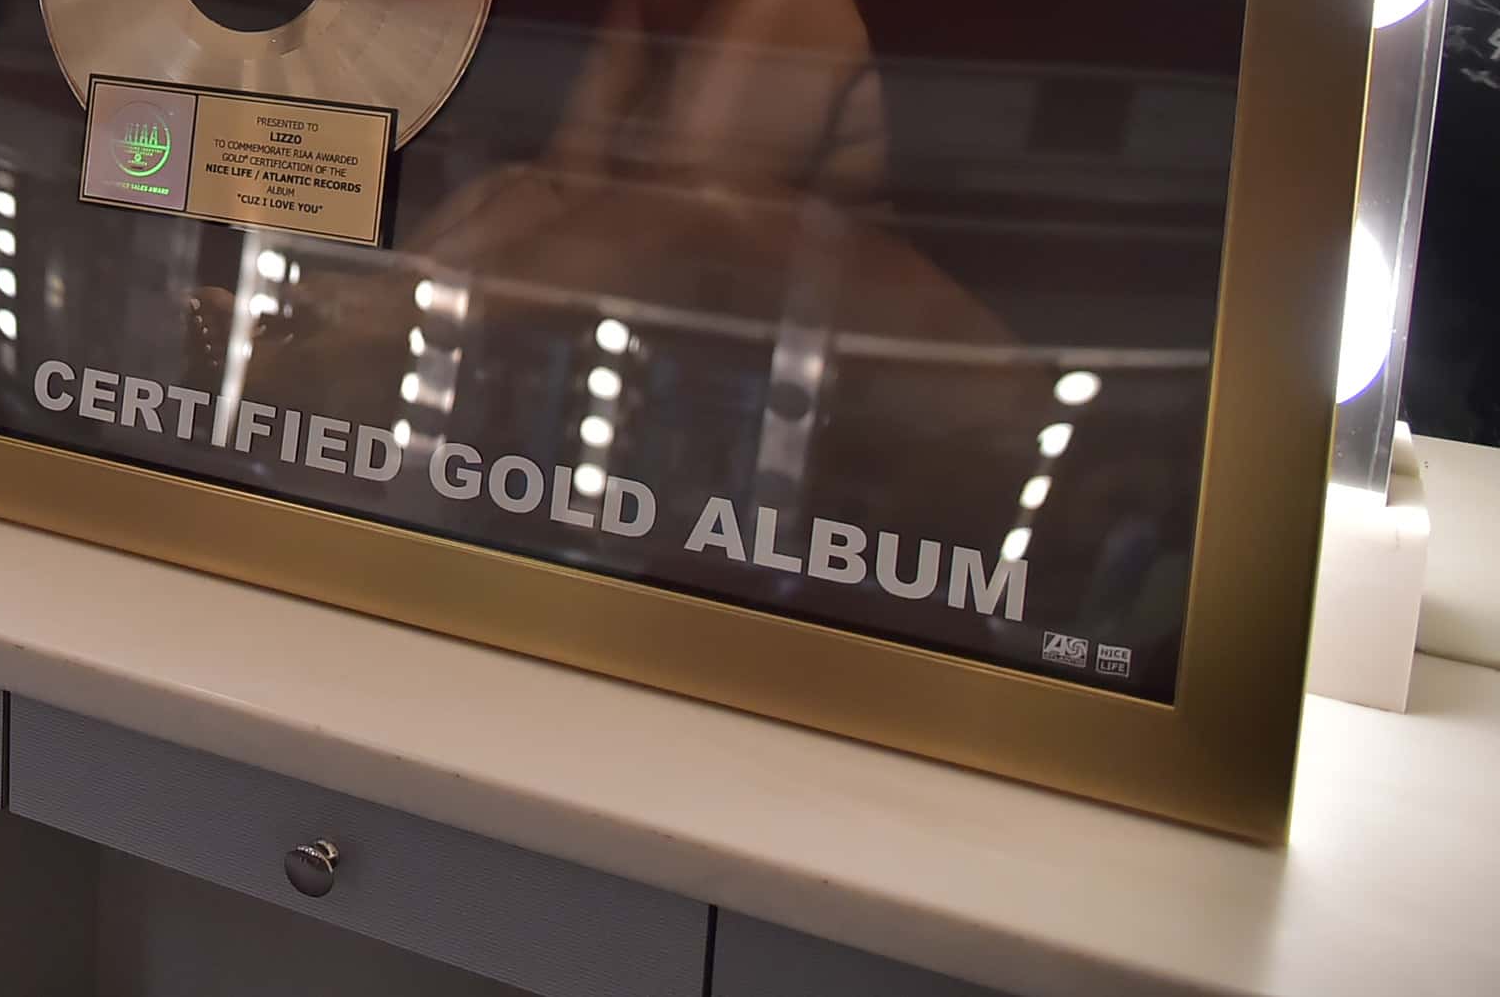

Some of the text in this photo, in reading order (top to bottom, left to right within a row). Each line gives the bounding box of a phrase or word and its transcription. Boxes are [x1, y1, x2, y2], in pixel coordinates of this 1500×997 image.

[256, 116, 319, 132] PRESENTED TO
[269, 131, 302, 145] LIZZO
[215, 139, 359, 166] TO COMMEMORATE RIAA AWARDED
[249, 157, 313, 174] CERTIFICATION
[315, 165, 329, 175] OF
[330, 167, 347, 178] THE
[205, 163, 229, 175] NICE
[231, 168, 253, 179] LIFE
[262, 171, 311, 187] ATLANTIC
[313, 178, 362, 194] RECORDS
[266, 185, 295, 197] ALBUM
[269, 199, 295, 211] LOVE
[33, 359, 1029, 623] CERTIFIED GOLD ALBUM
[1100, 660, 1125, 673] LIFE
